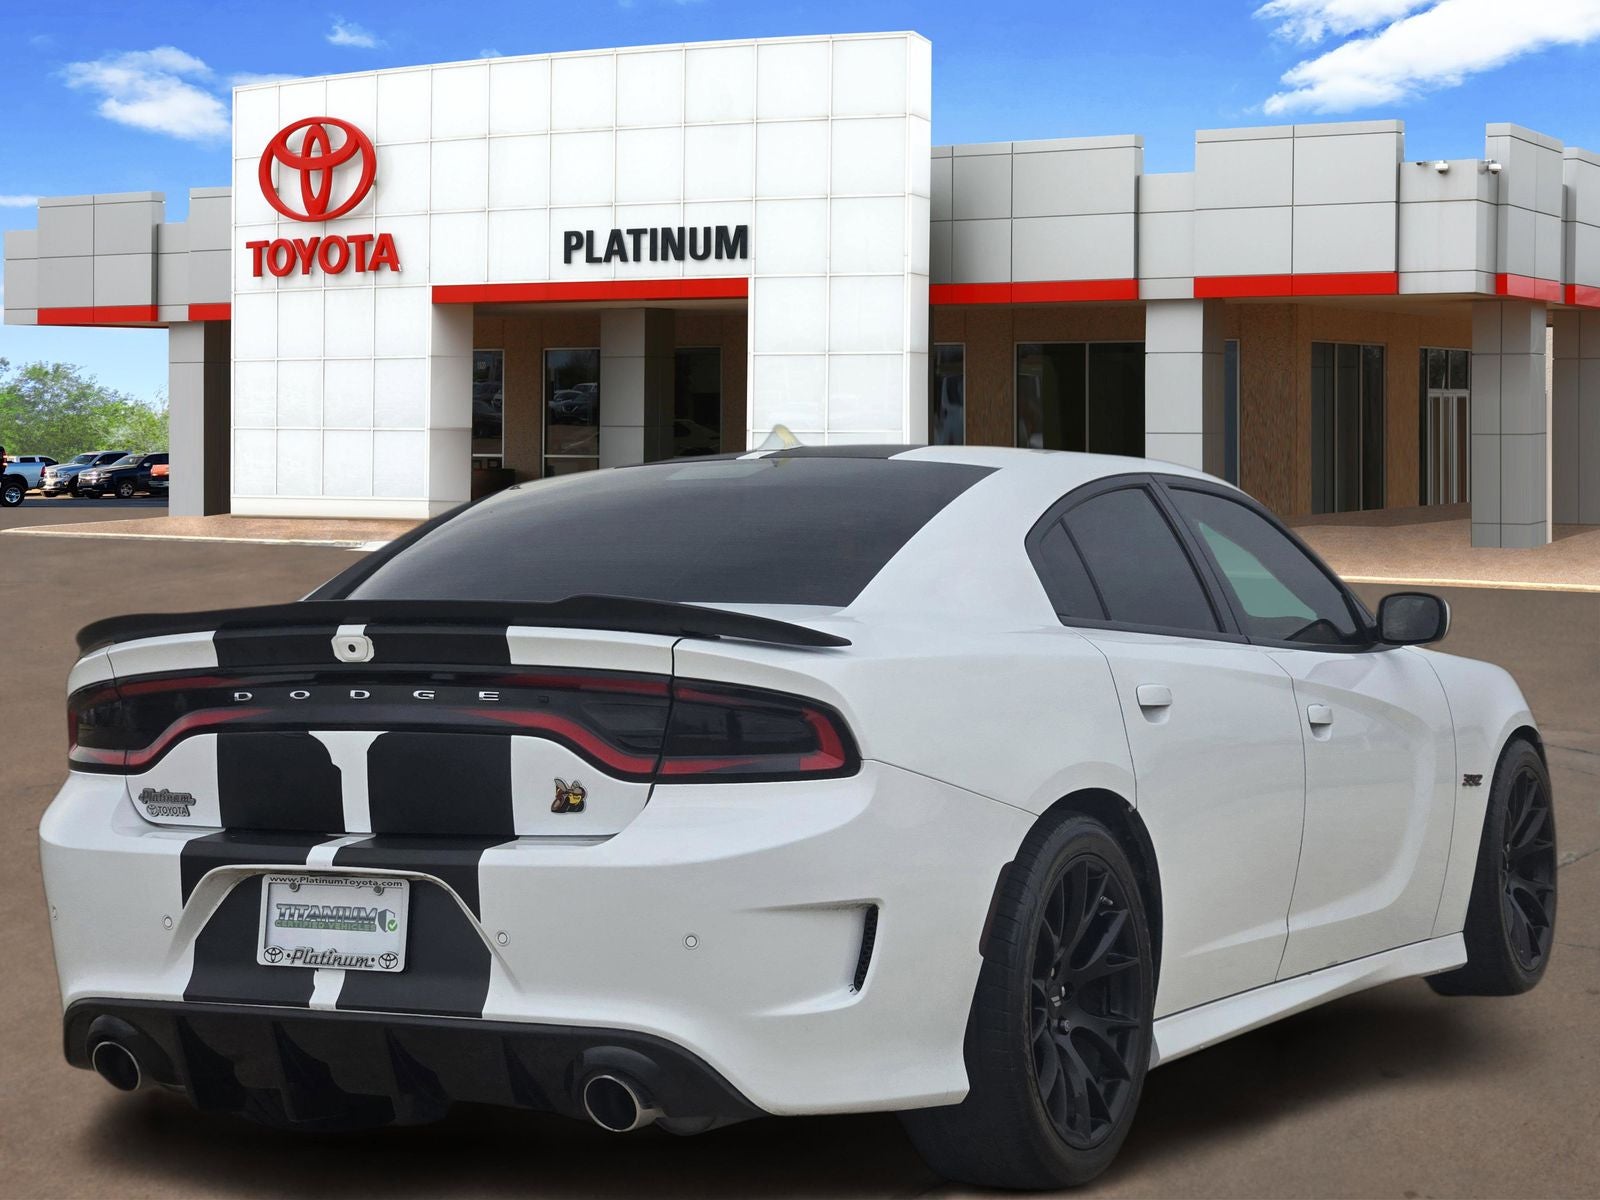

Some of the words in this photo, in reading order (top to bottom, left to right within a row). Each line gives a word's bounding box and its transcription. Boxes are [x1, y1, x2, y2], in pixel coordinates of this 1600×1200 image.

[563, 225, 749, 265] PLATINUM
[246, 233, 401, 277] TOYOTA
[234, 689, 500, 701] DODGE
[158, 805, 191, 817] TOYOTA
[269, 875, 403, 887] www.PlatinumToyota.com
[276, 903, 378, 924] TITANIUM
